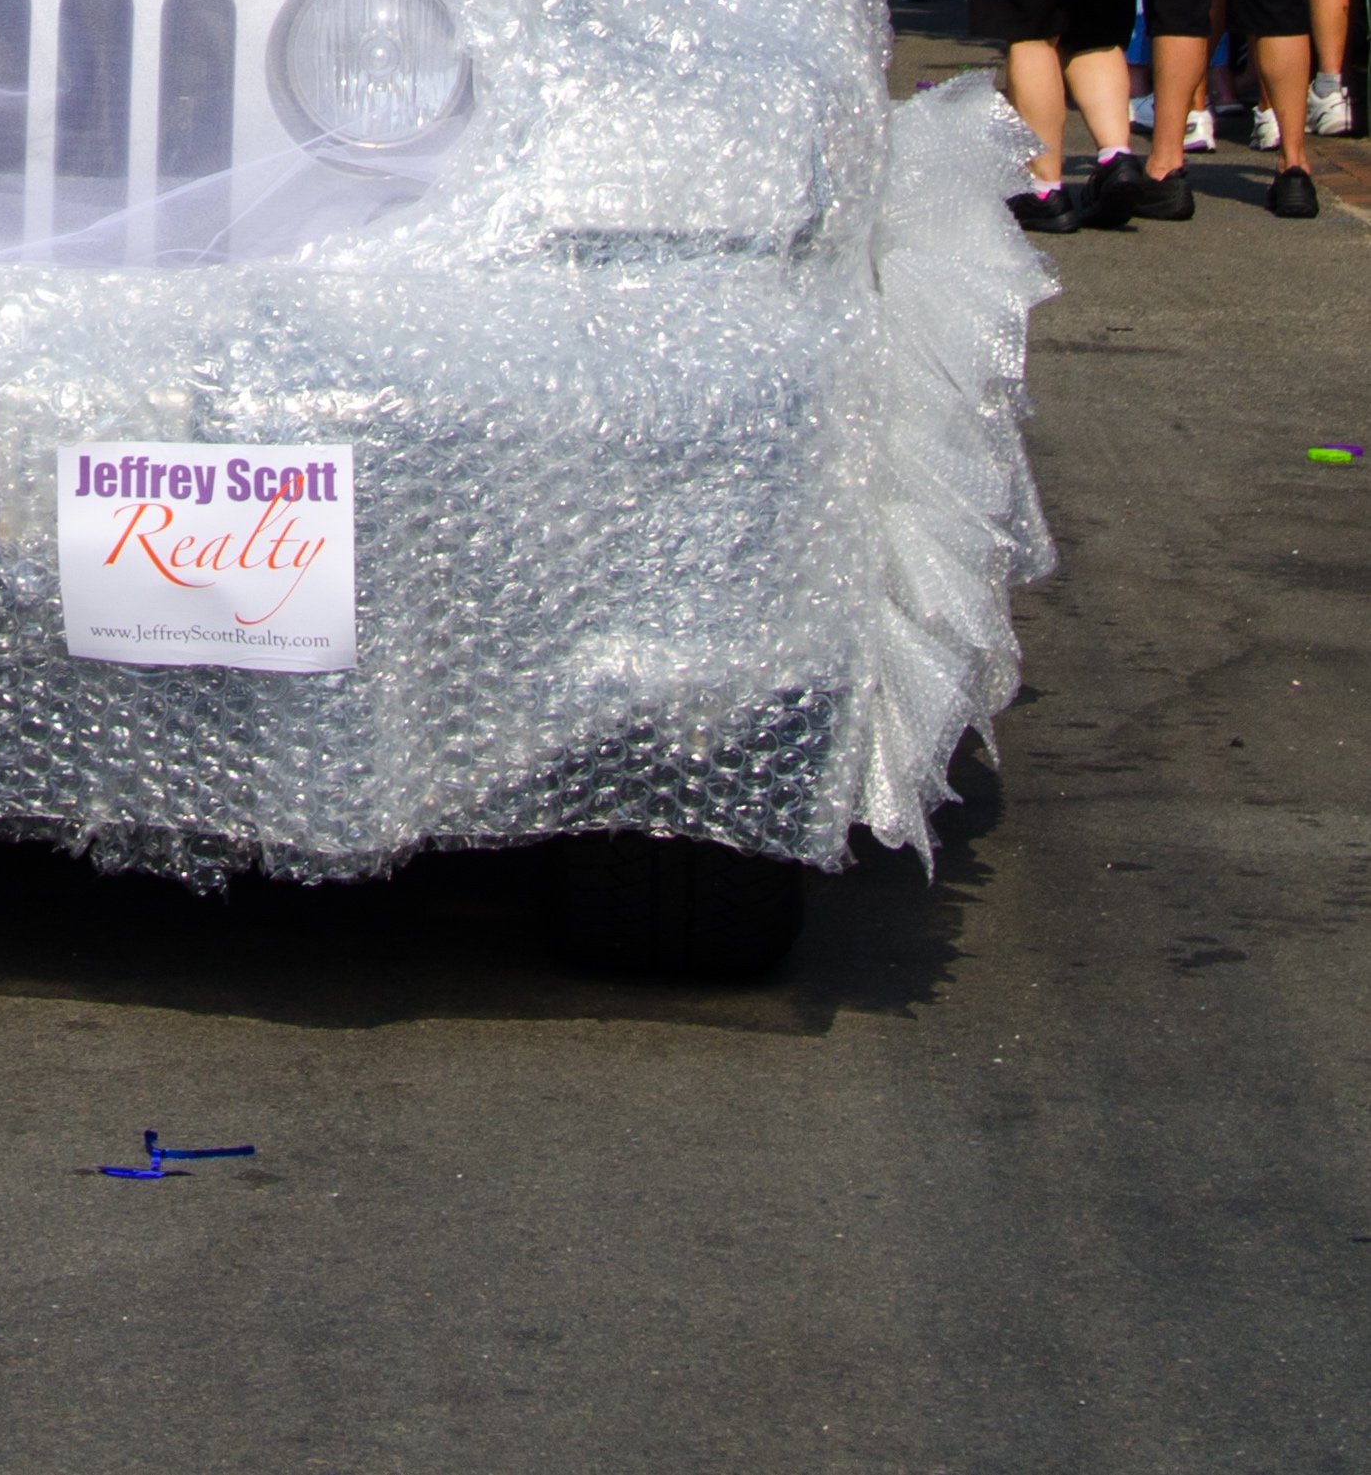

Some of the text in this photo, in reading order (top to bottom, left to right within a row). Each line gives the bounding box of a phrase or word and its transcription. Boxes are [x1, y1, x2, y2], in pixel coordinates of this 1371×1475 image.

[75, 455, 338, 505] Jeffrey Scott
[102, 475, 326, 625] Realty
[90, 624, 330, 649] www.JeffreyScottRealty.com
